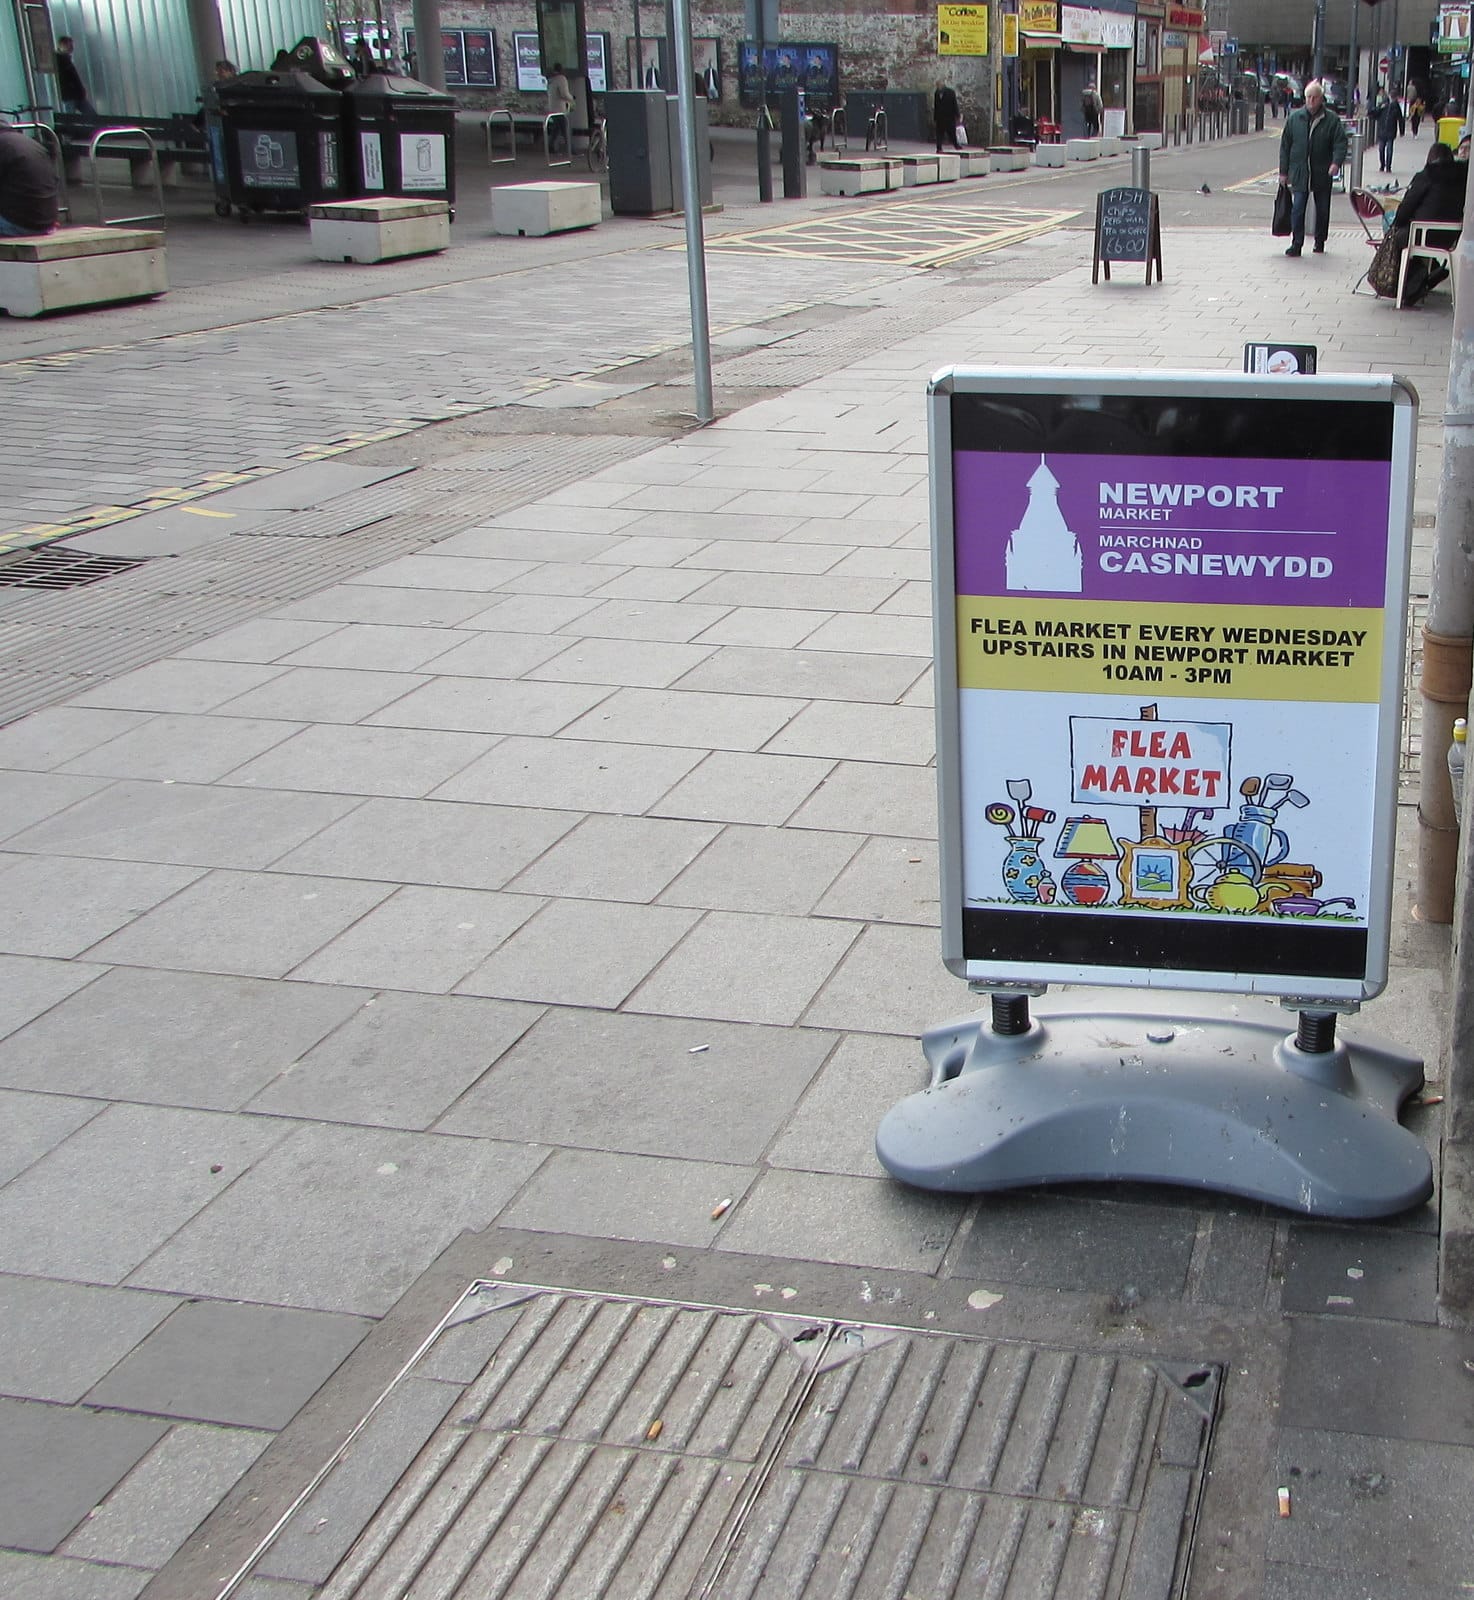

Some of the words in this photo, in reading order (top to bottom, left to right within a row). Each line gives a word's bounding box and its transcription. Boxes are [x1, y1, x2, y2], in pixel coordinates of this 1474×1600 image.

[1109, 190, 1144, 205] FISH
[1099, 481, 1284, 508] NEWPORT
[1099, 507, 1173, 521] MARKET
[1099, 535, 1203, 550] MARCHNAD
[1099, 551, 1334, 579] CASNEWYDD
[970, 617, 1028, 636] FLEA
[1034, 620, 1132, 640] MARKET
[1138, 624, 1216, 642] EVERY
[1222, 627, 1368, 647] WEDNESDAY
[982, 639, 1096, 659] UPSTAIRS
[1102, 644, 1126, 660] IN
[1134, 645, 1249, 664] NEWPORT
[1256, 649, 1355, 668] MARKET
[1102, 664, 1164, 682] 10AM
[1184, 667, 1232, 685] 3PM
[1111, 729, 1192, 760] FLEA
[1080, 764, 1222, 798] MARKET
